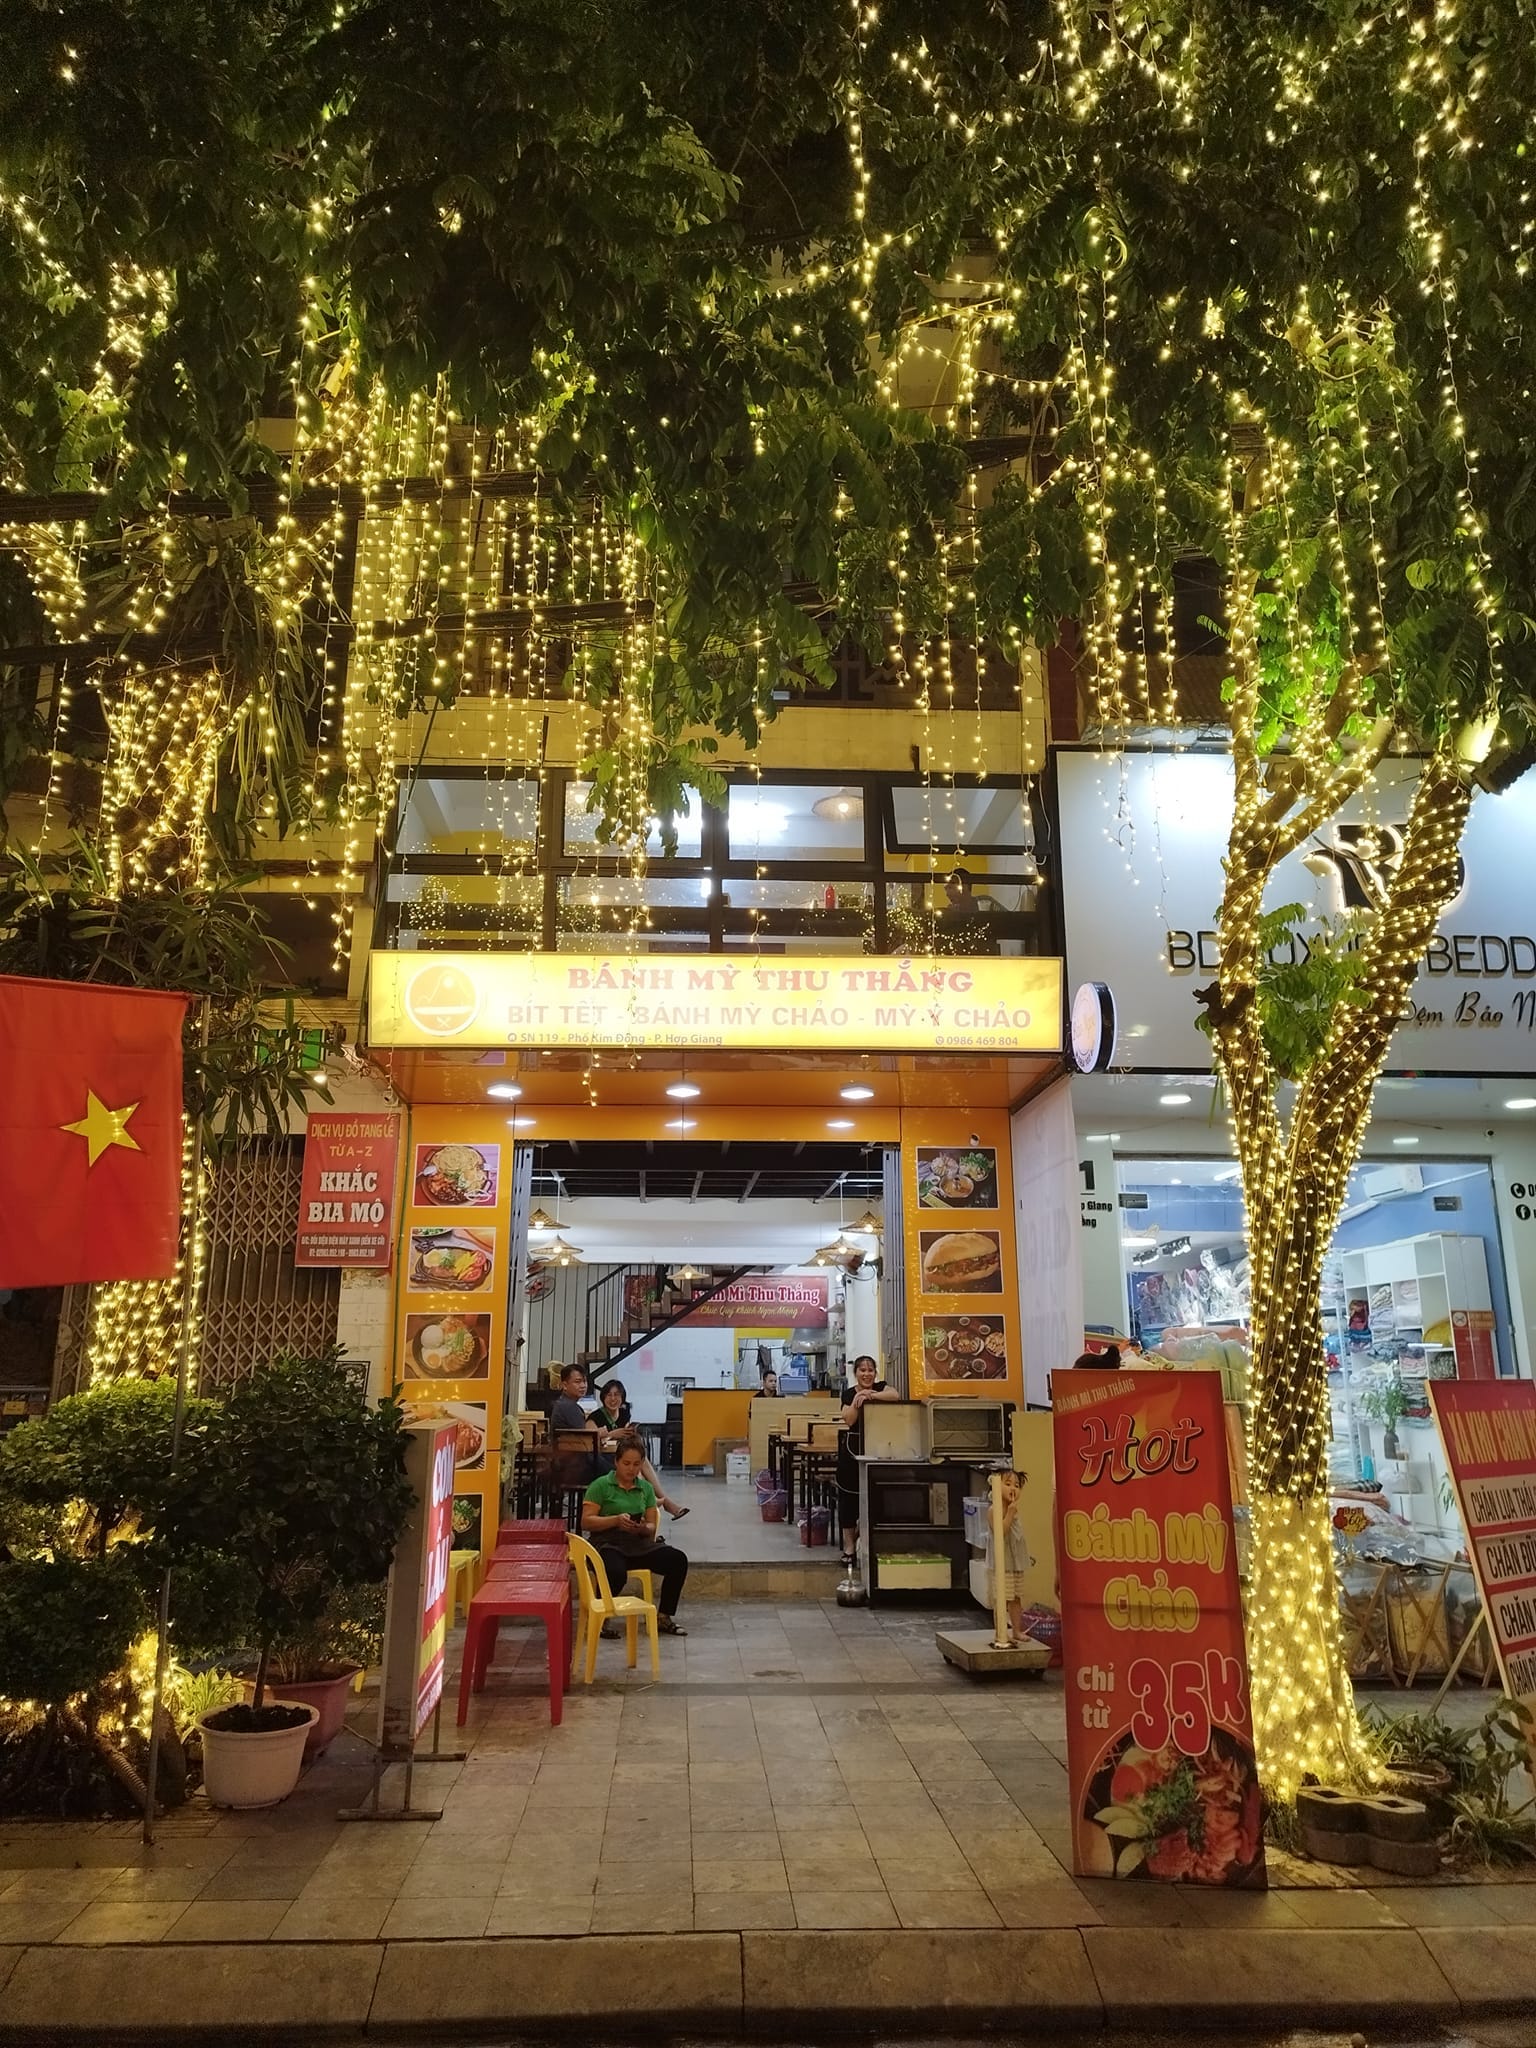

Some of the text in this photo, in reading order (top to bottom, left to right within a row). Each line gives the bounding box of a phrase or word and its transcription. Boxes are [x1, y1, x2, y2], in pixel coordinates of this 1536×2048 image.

[567, 960, 973, 993] BÁNH MỲ THU THẮNG
[633, 1001, 710, 1024] BÁNH
[772, 1000, 848, 1026] CHẢO
[954, 1001, 1031, 1028] CHẢO
[539, 1033, 558, 1042] 119
[592, 1033, 613, 1042] Kim
[690, 1034, 723, 1045] Giang
[946, 1036, 1018, 1046] 0986 469 804
[312, 1124, 331, 1140] DỊCH
[333, 1124, 345, 1141] VỤ
[360, 1124, 383, 1138] TANG
[346, 1146, 355, 1156] A
[365, 1146, 373, 1156] Z
[320, 1164, 378, 1192] KHẮC
[308, 1199, 385, 1227] BIA MỘ
[728, 1284, 746, 1302] Mì
[748, 1285, 775, 1302] Thu
[1079, 1414, 1204, 1487] Hot
[1064, 1503, 1228, 1573] Bánh Mỳ
[1486, 1537, 1523, 1579] CHĂN
[1103, 1568, 1200, 1633] Chảo
[1082, 1698, 1112, 1729] từ
